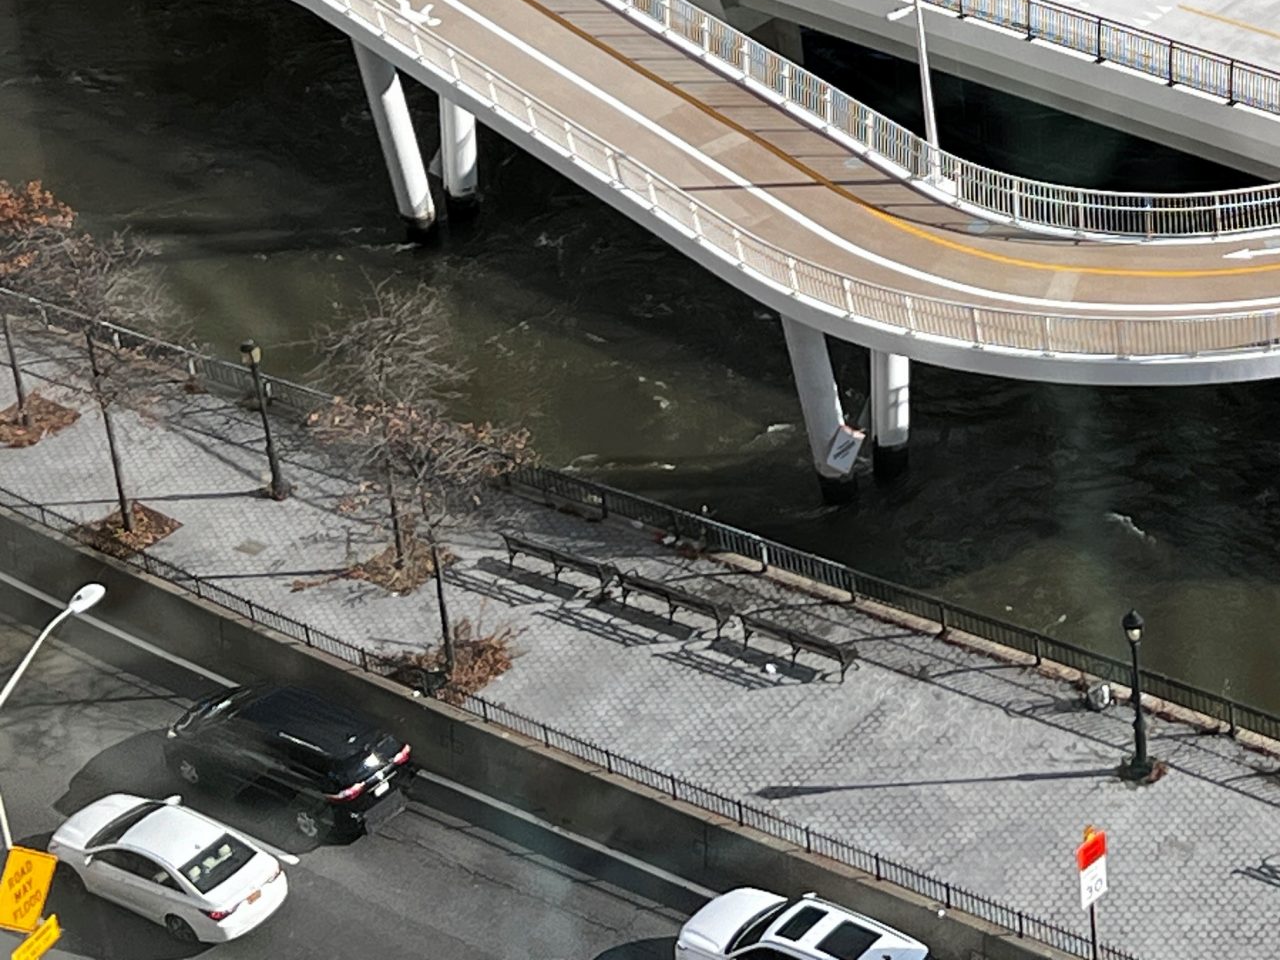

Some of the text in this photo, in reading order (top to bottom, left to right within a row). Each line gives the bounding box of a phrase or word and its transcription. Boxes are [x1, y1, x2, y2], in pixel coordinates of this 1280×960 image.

[8, 860, 33, 889] ROAD
[14, 877, 33, 903] MAY
[1087, 878, 1102, 899] 30
[13, 889, 41, 922] FLOOD
